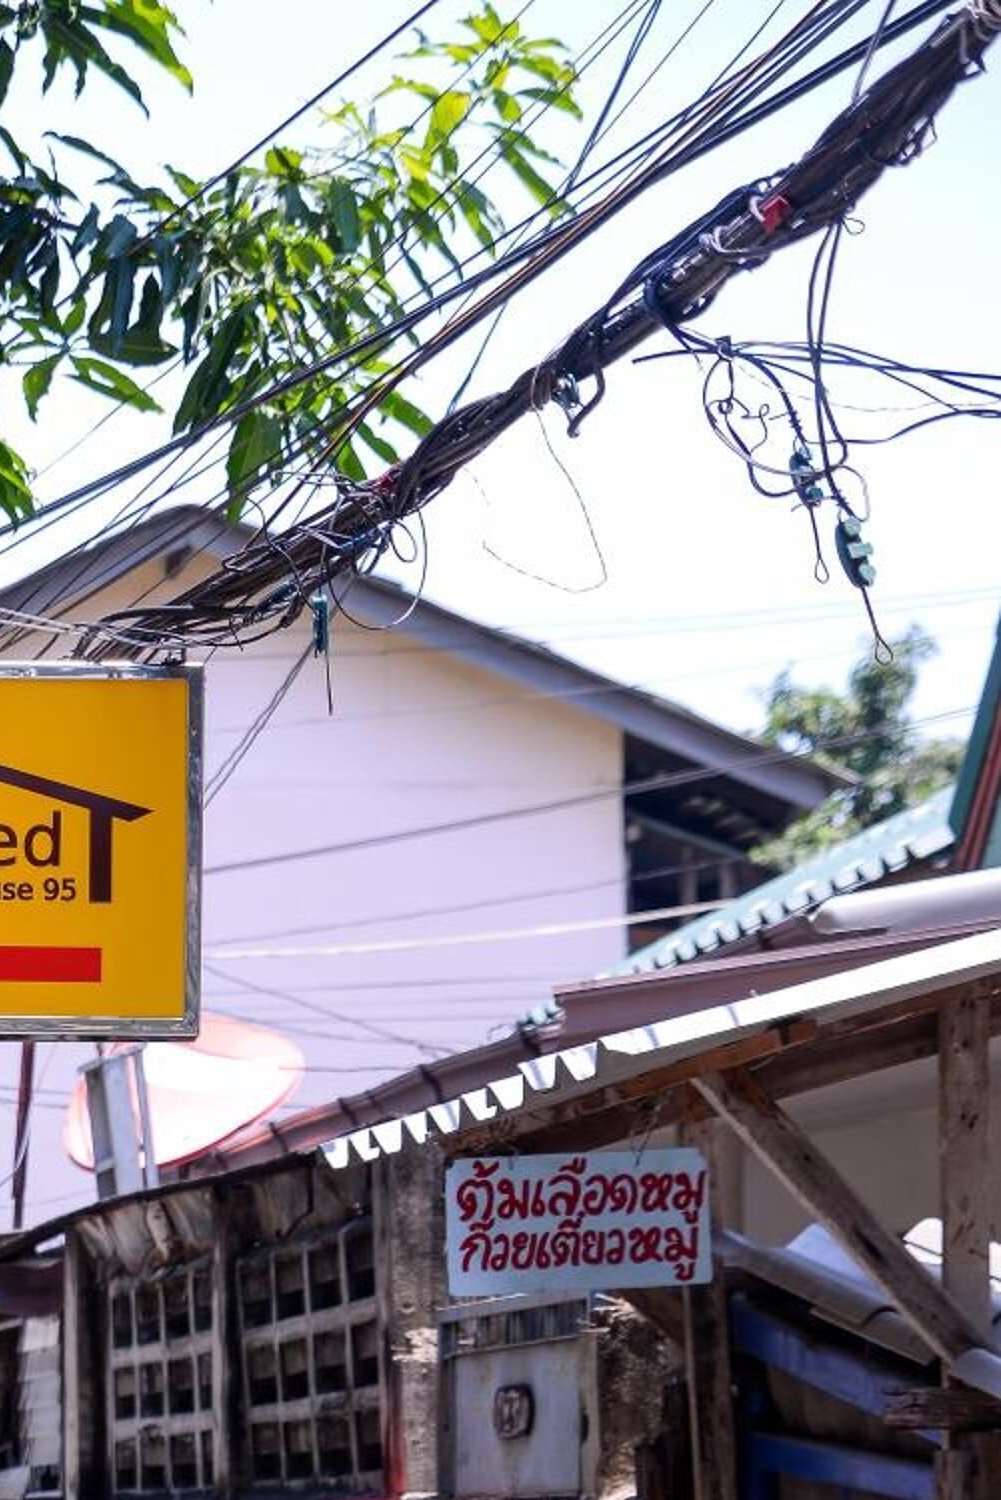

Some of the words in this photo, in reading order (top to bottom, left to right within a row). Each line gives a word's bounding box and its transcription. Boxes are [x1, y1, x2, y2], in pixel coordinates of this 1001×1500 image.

[43, 878, 77, 902] 95
[456, 1158, 706, 1224] ต้มเลือดหมู
